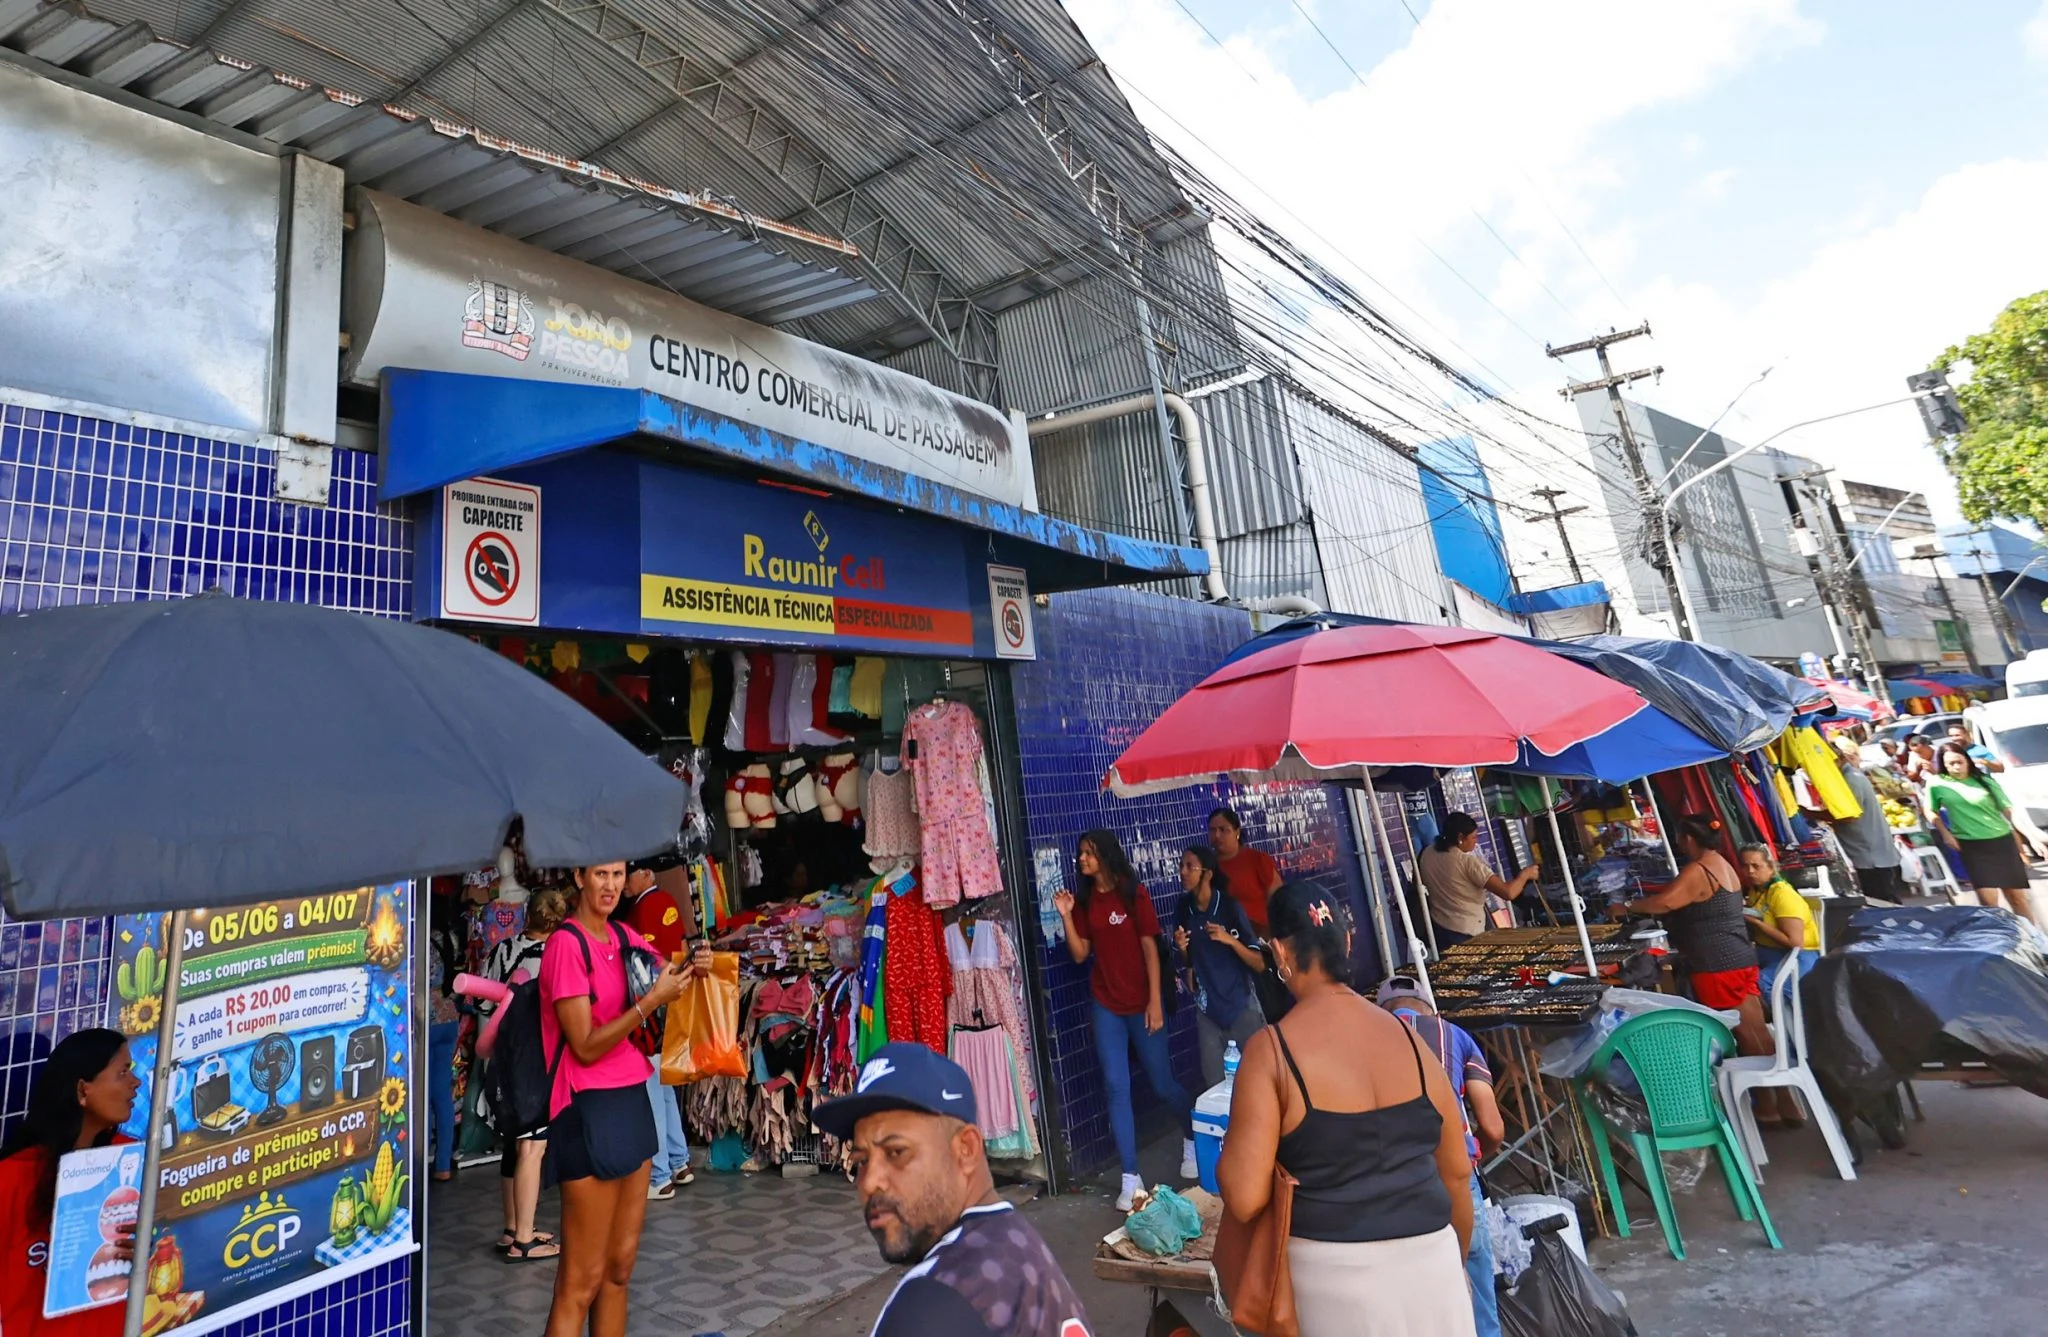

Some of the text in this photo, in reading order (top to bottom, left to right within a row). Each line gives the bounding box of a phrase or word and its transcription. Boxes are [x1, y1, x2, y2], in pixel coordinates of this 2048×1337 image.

[539, 330, 630, 379] PESSOA
[541, 361, 559, 370] PRA
[562, 366, 588, 377] VIVER
[649, 333, 998, 468] CENTRO COMERCIAL DE PASSAGEM
[451, 490, 534, 512] PROIBIDA ENTRADA COM
[462, 506, 523, 532] CAPACETE
[812, 521, 819, 537] R
[662, 586, 934, 633] ASSISTÊNCIA TÉCNICA ESPECIALIZADA
[997, 585, 1022, 599] CAPACETE
[183, 893, 358, 951] De 05/06 a 04/07
[180, 942, 356, 987] Suas compras valem prêmios!
[188, 981, 349, 1028] A cada R$ 20,00 em compras,
[191, 999, 347, 1049] ganhe 1 cupom para concorrer!
[62, 1163, 112, 1180] Odontomed
[160, 1111, 367, 1188] Fogueira de prêmios do CCP,
[181, 1173, 244, 1207] compre
[248, 1170, 258, 1185] e
[262, 1145, 331, 1185] participe
[223, 1214, 301, 1269] CCP
[222, 1271, 242, 1283] CENTRO
[243, 1261, 271, 1275] COMERCIAL
[279, 1249, 302, 1261] PASSAGEM
[249, 1271, 264, 1281] DESDE
